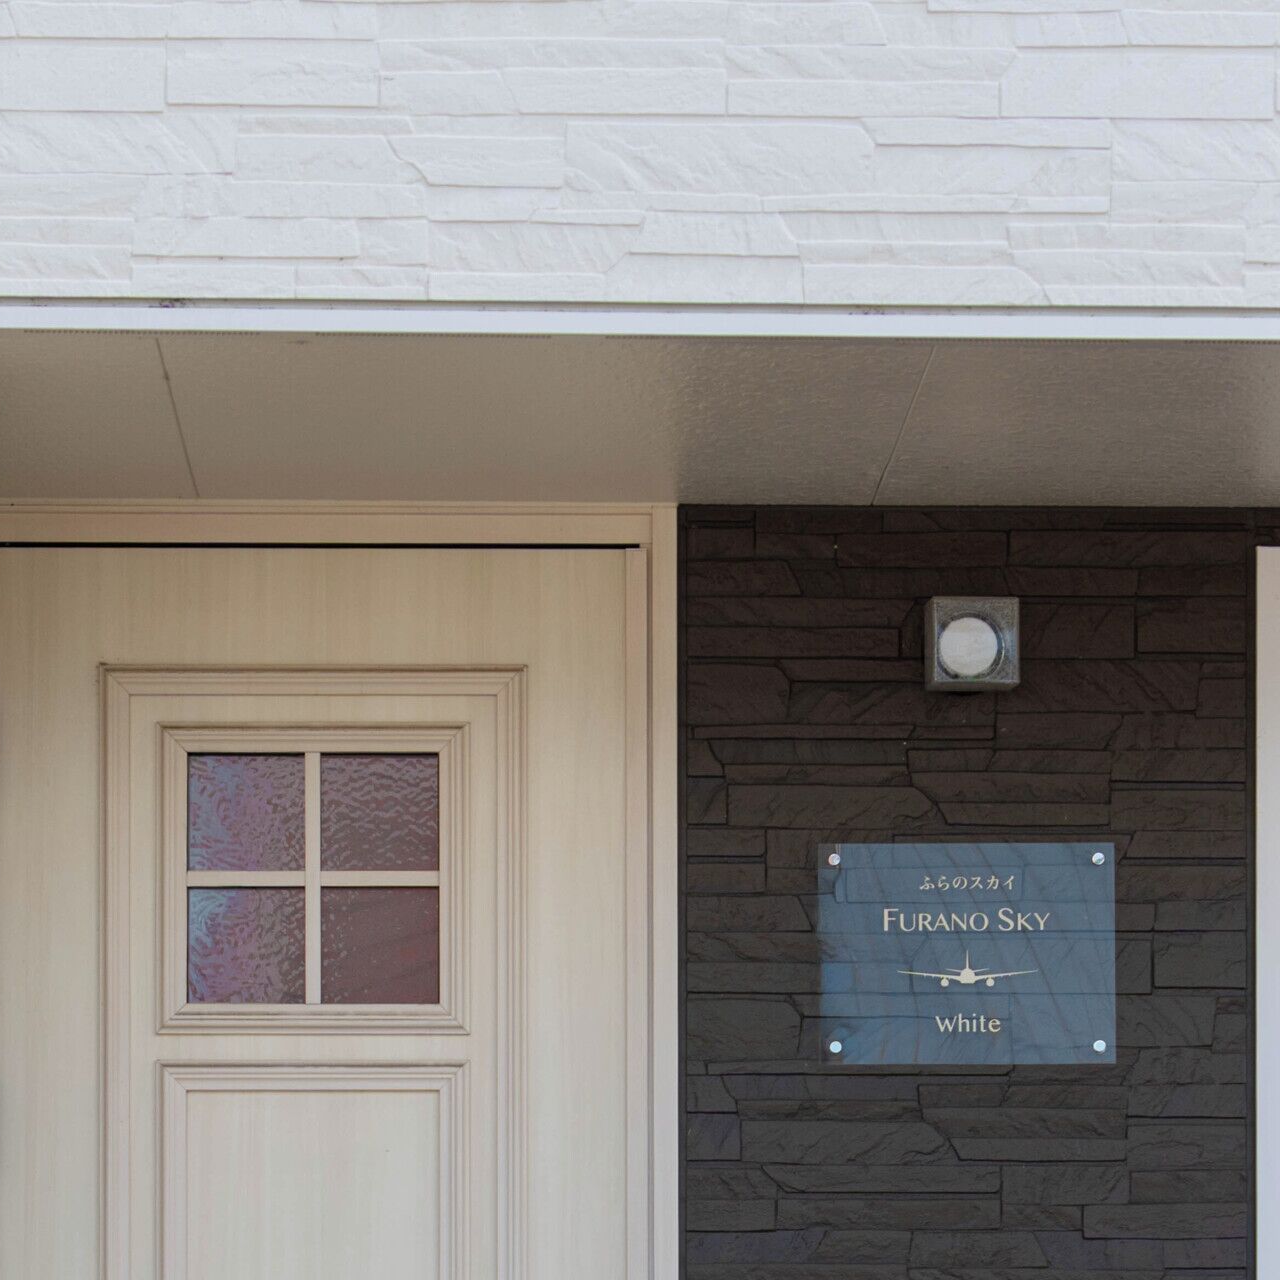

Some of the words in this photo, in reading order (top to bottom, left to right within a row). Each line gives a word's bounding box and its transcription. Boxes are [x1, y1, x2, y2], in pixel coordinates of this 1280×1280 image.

[919, 875, 1015, 891] ふらのスカイ
[883, 908, 989, 932] FURANO
[997, 907, 1051, 932] SKY
